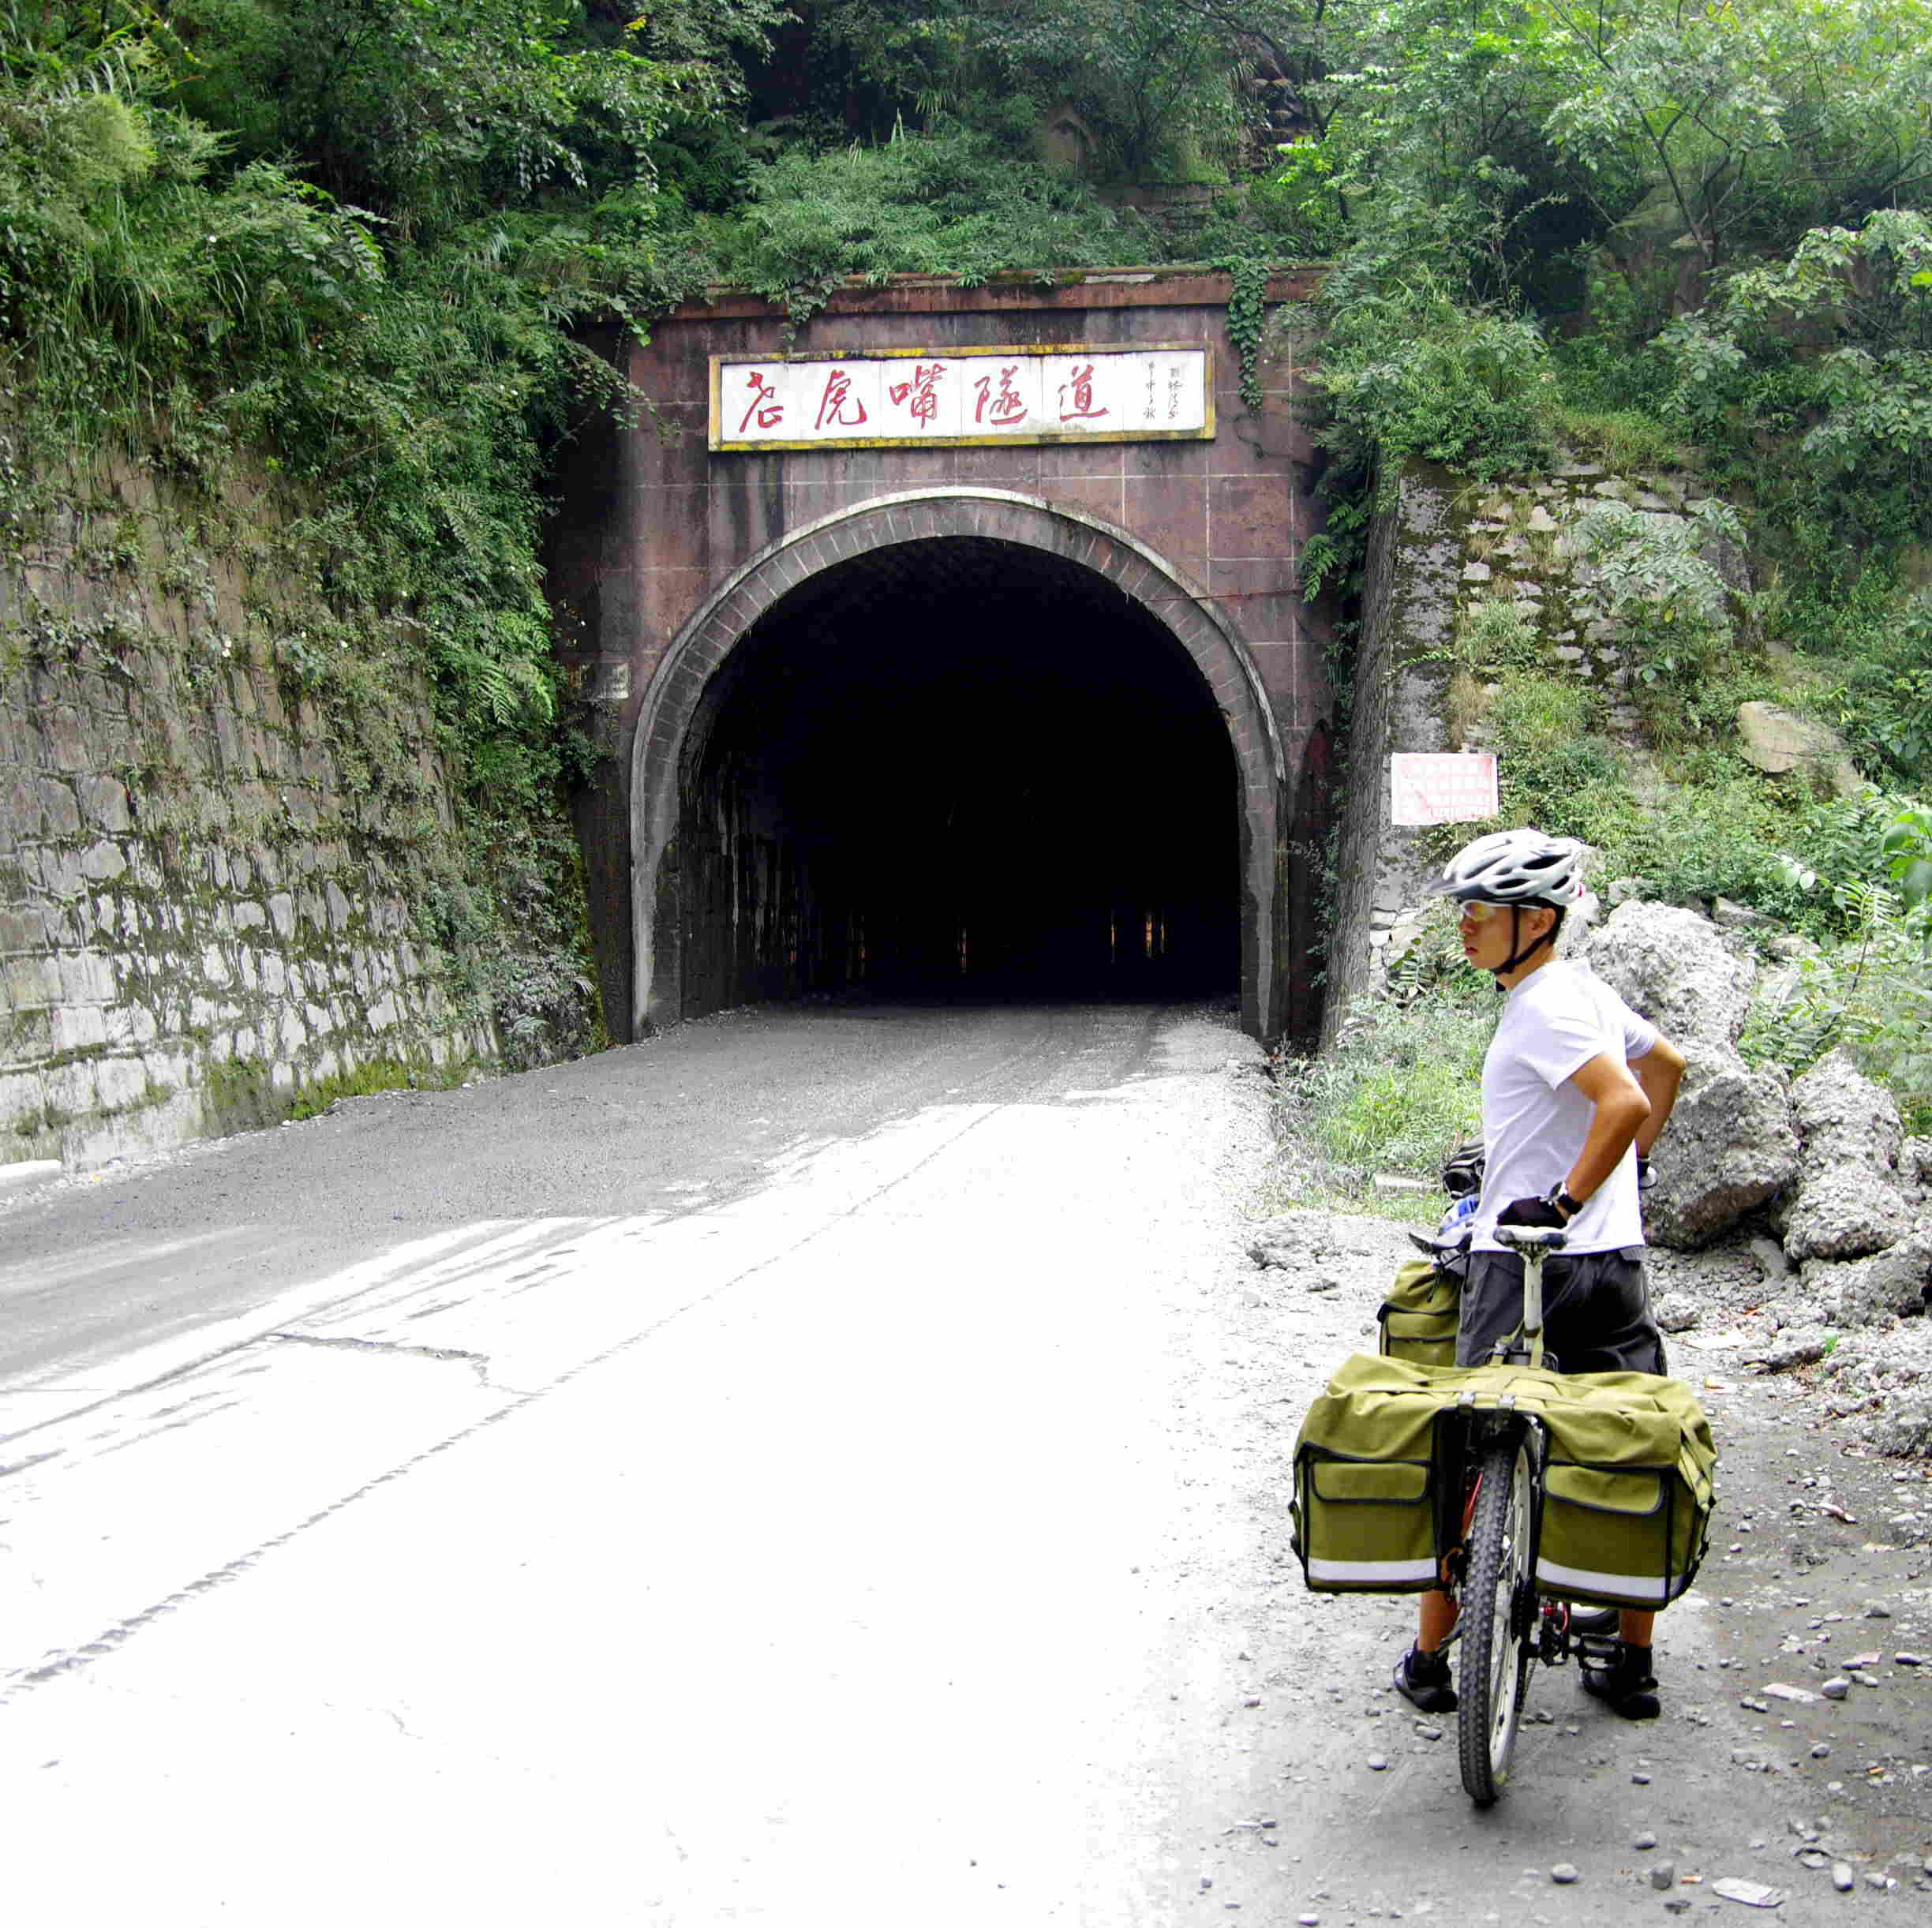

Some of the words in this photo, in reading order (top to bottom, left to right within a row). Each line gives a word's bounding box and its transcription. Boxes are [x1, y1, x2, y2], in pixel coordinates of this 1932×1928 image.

[739, 364, 1109, 432] 老虎嘴隧道
